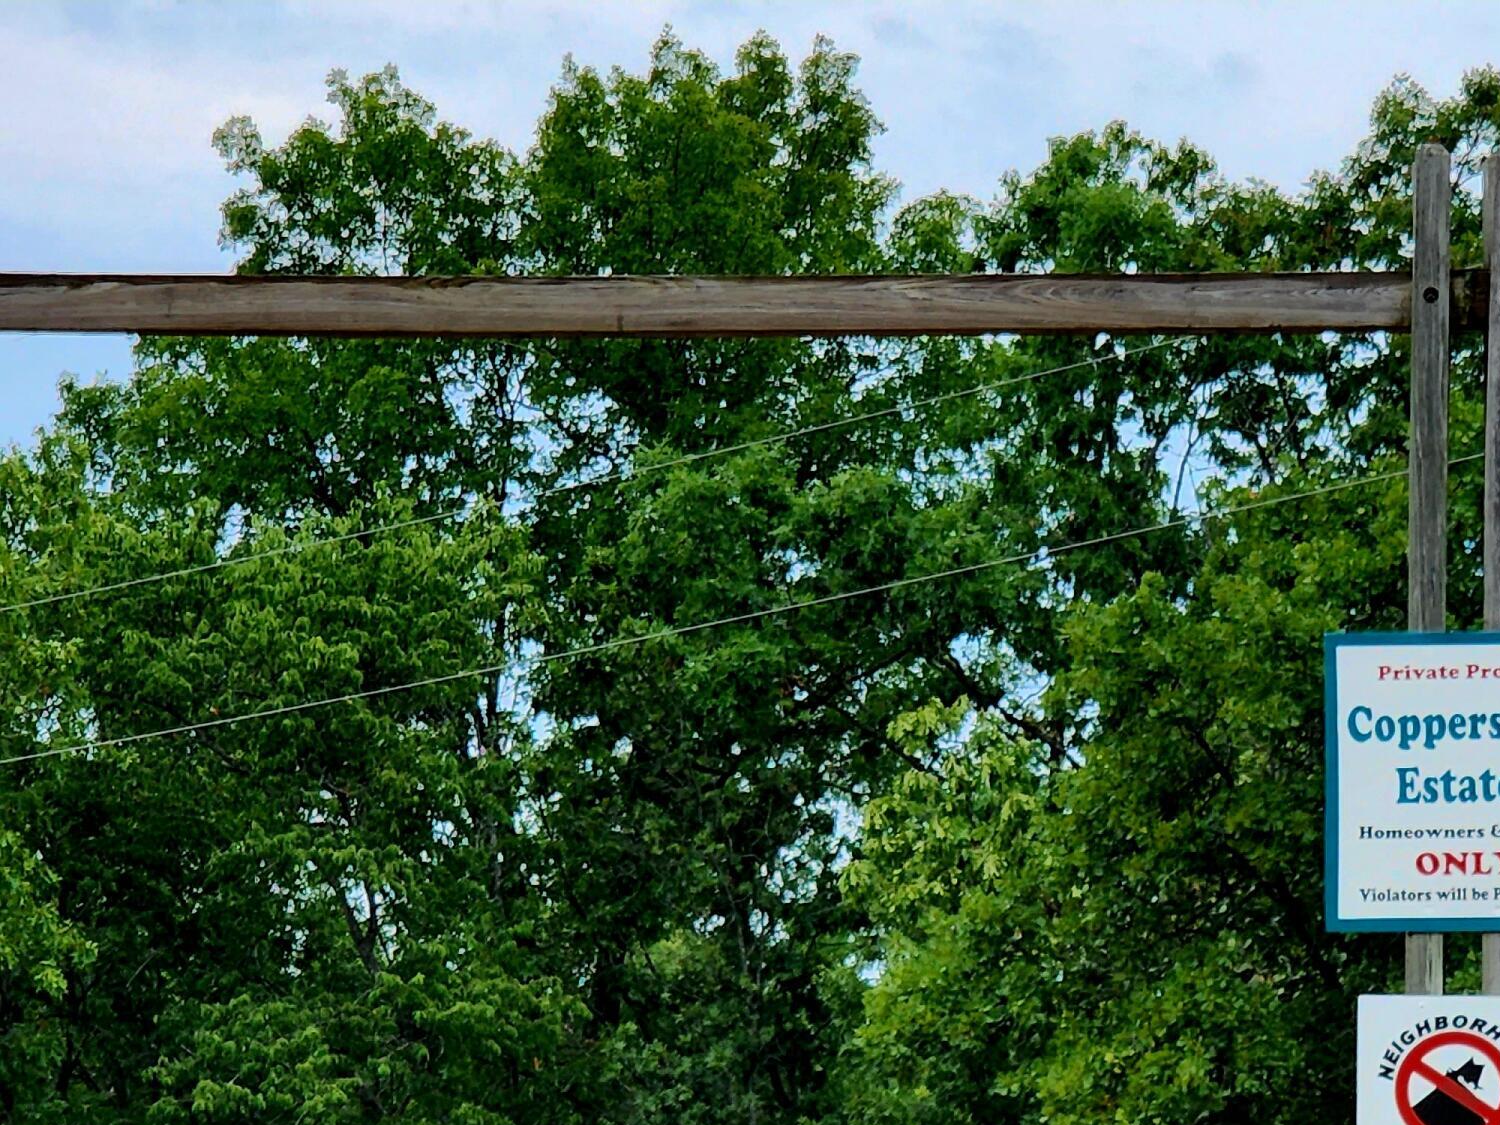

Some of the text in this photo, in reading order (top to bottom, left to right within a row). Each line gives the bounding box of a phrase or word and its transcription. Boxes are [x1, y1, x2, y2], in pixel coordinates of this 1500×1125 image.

[1378, 664, 1459, 681] Private
[1359, 825, 1485, 839] Homeowners
[1359, 888, 1432, 902] Violators
[1435, 887, 1467, 901] will
[1472, 887, 1489, 901] be
